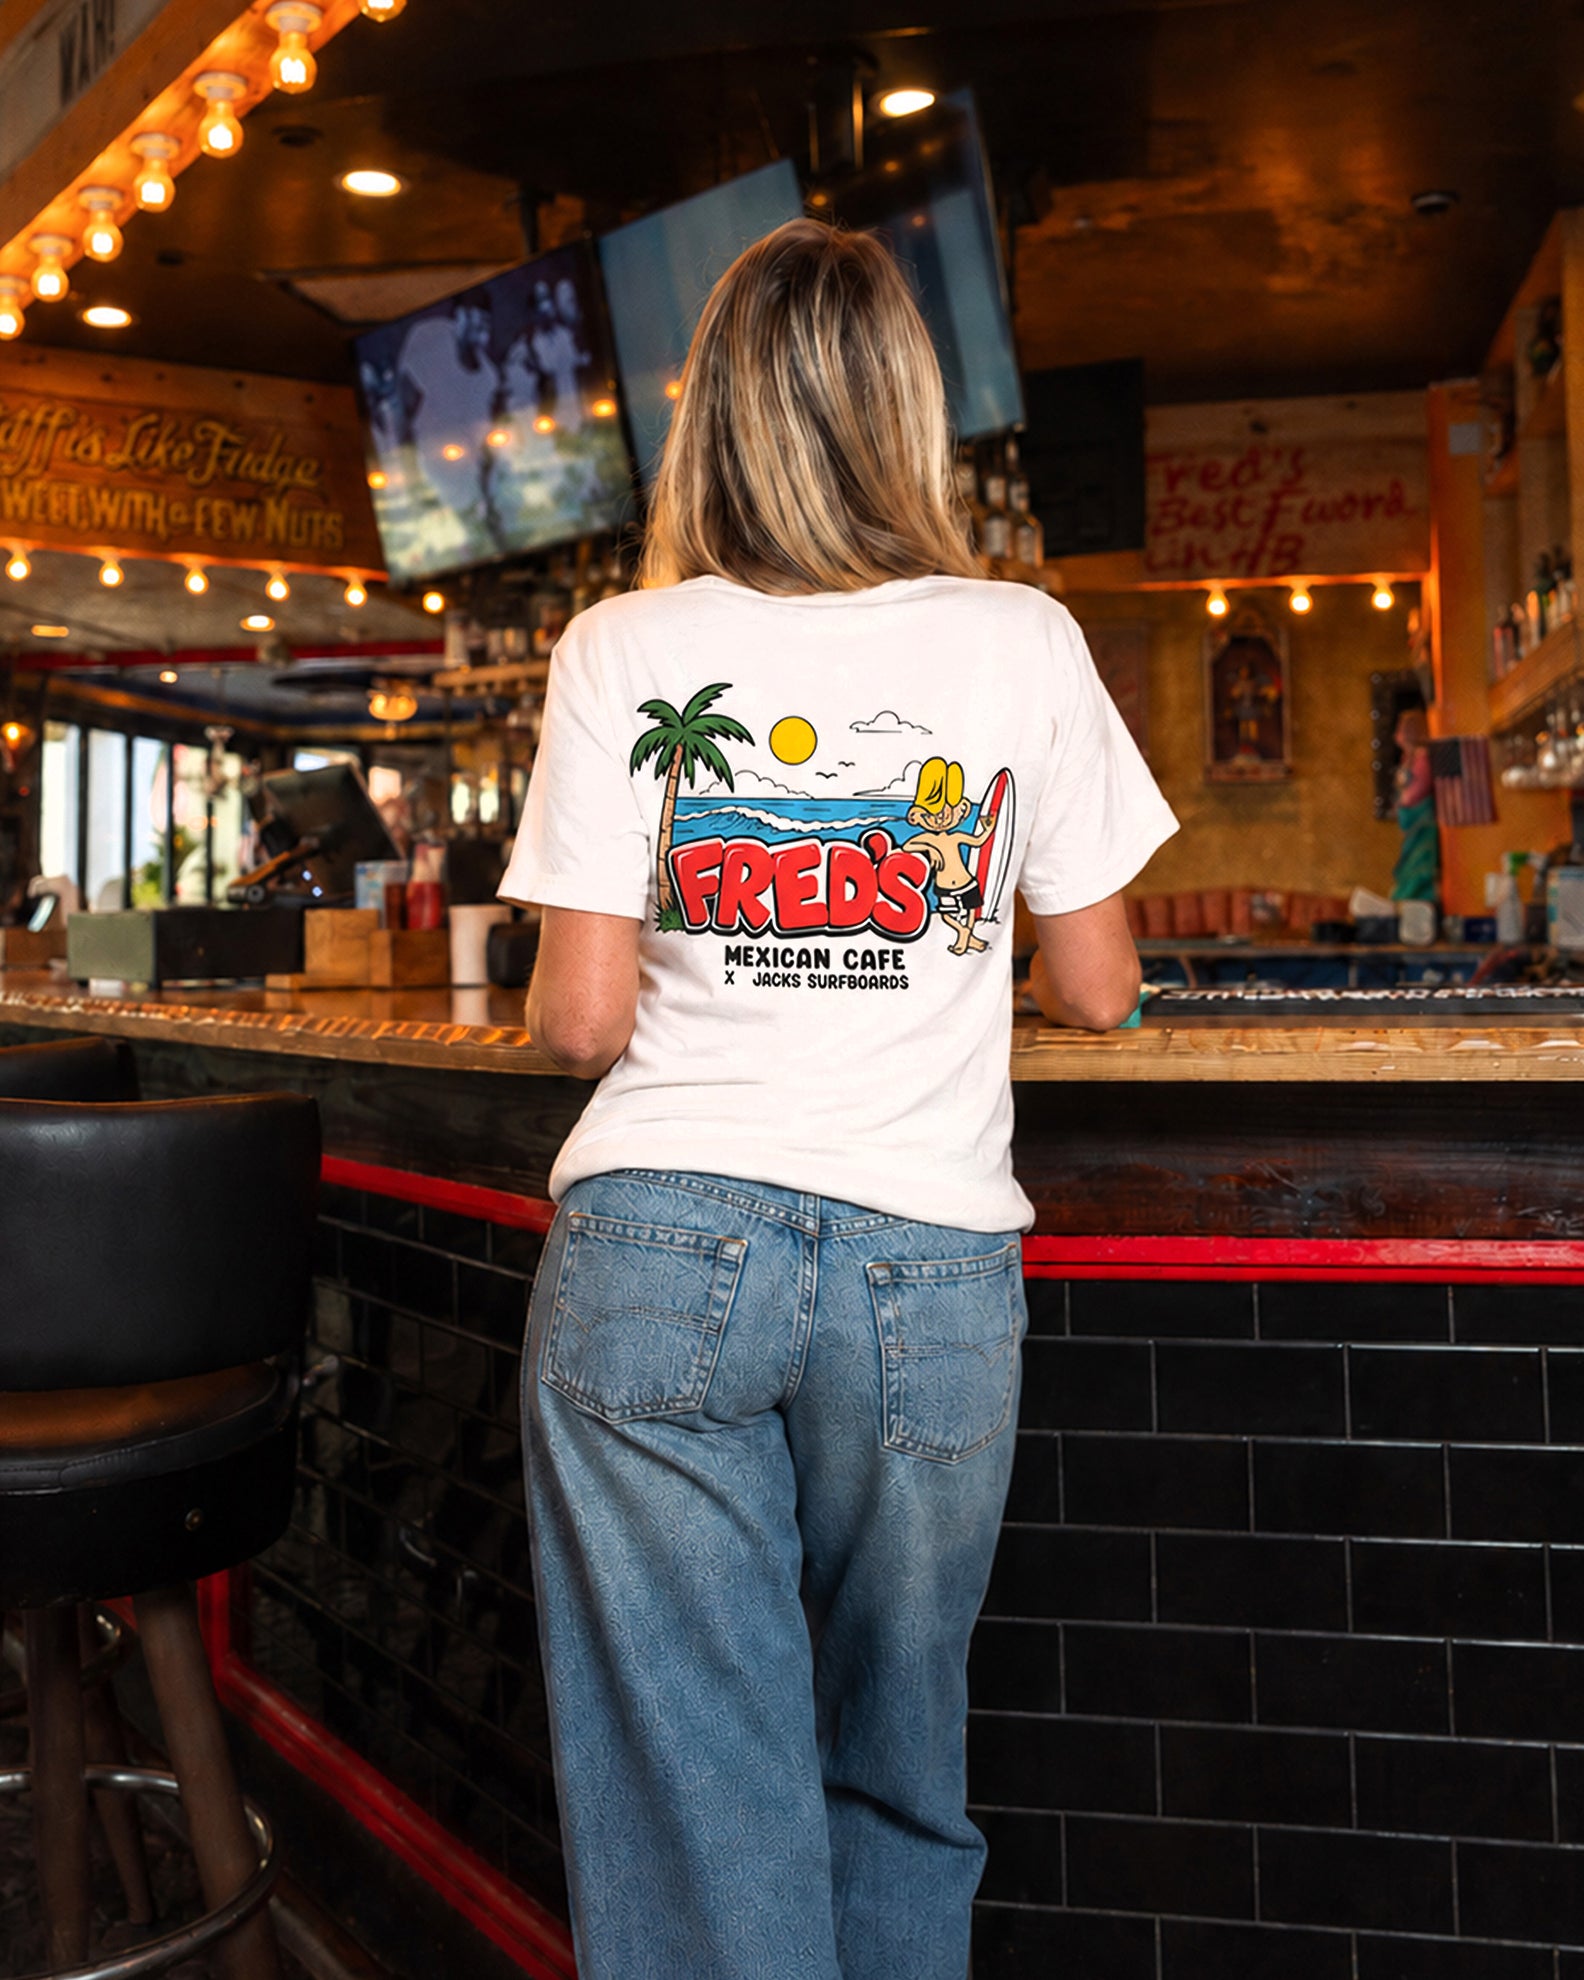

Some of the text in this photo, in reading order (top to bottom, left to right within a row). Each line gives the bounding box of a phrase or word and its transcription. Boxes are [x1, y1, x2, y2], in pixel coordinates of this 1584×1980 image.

[0, 404, 77, 478] aff
[104, 412, 196, 470] Like
[0, 479, 89, 530] WEET,
[87, 485, 168, 540] WITH
[194, 497, 257, 540] FEW
[265, 495, 344, 548] NUTS
[669, 830, 930, 941] FRED'S
[724, 945, 906, 971] MEXICAN CAFE
[724, 970, 909, 991] X JACKS SURFBOARDS
